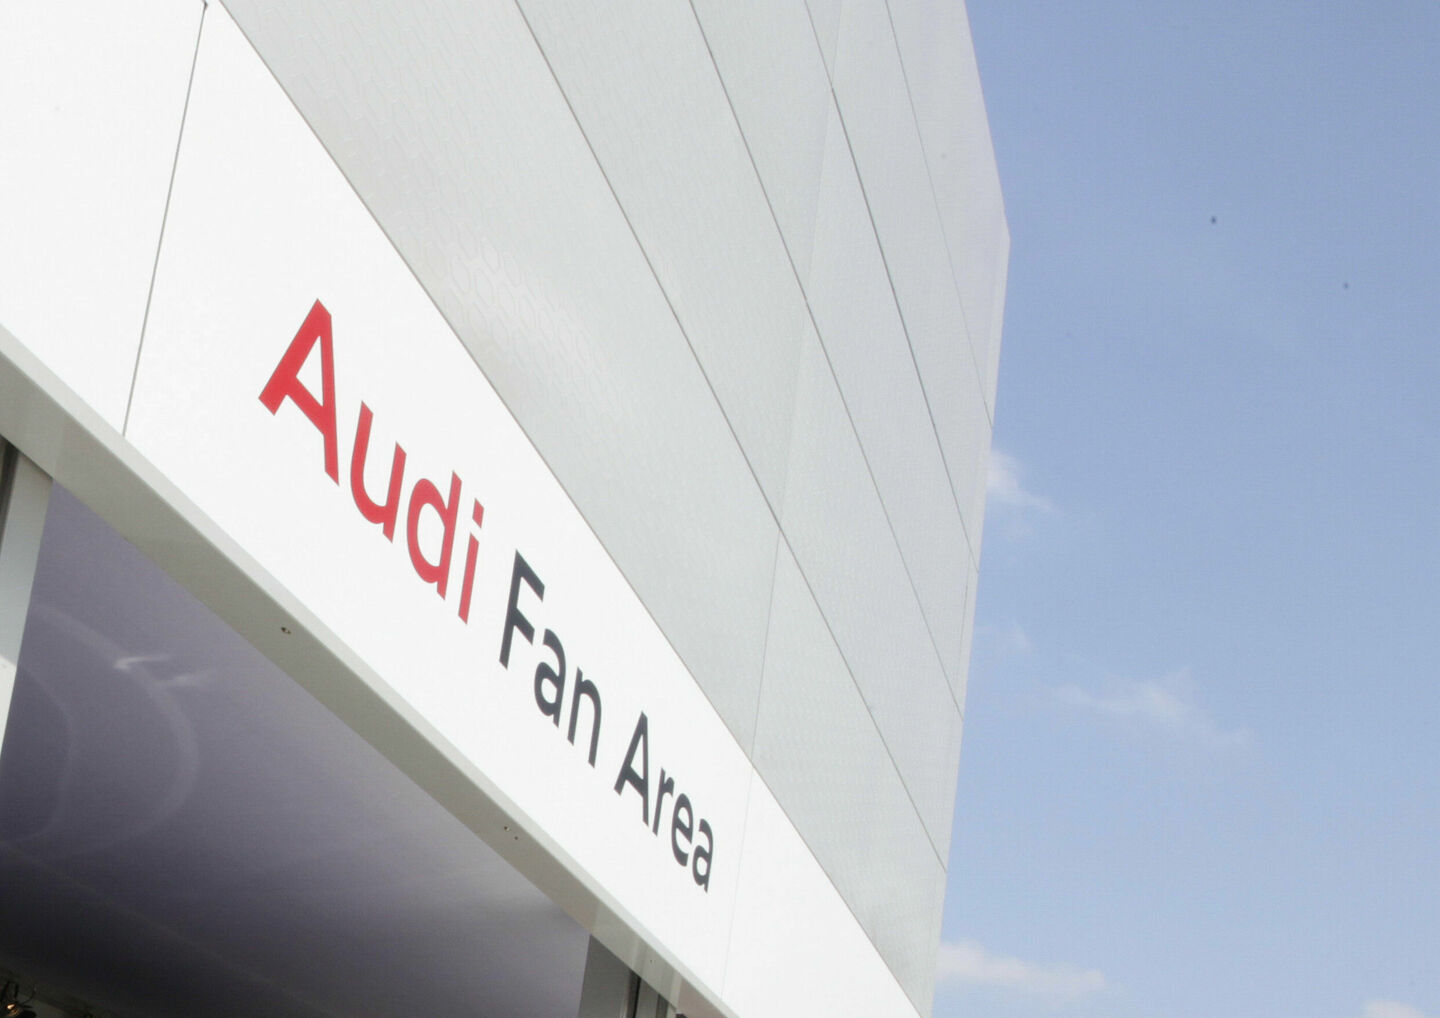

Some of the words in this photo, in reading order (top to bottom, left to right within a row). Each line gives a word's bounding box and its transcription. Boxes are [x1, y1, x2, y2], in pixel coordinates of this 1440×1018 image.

[258, 298, 484, 625] Audi
[499, 549, 602, 769] Fan
[613, 711, 714, 893] Area
